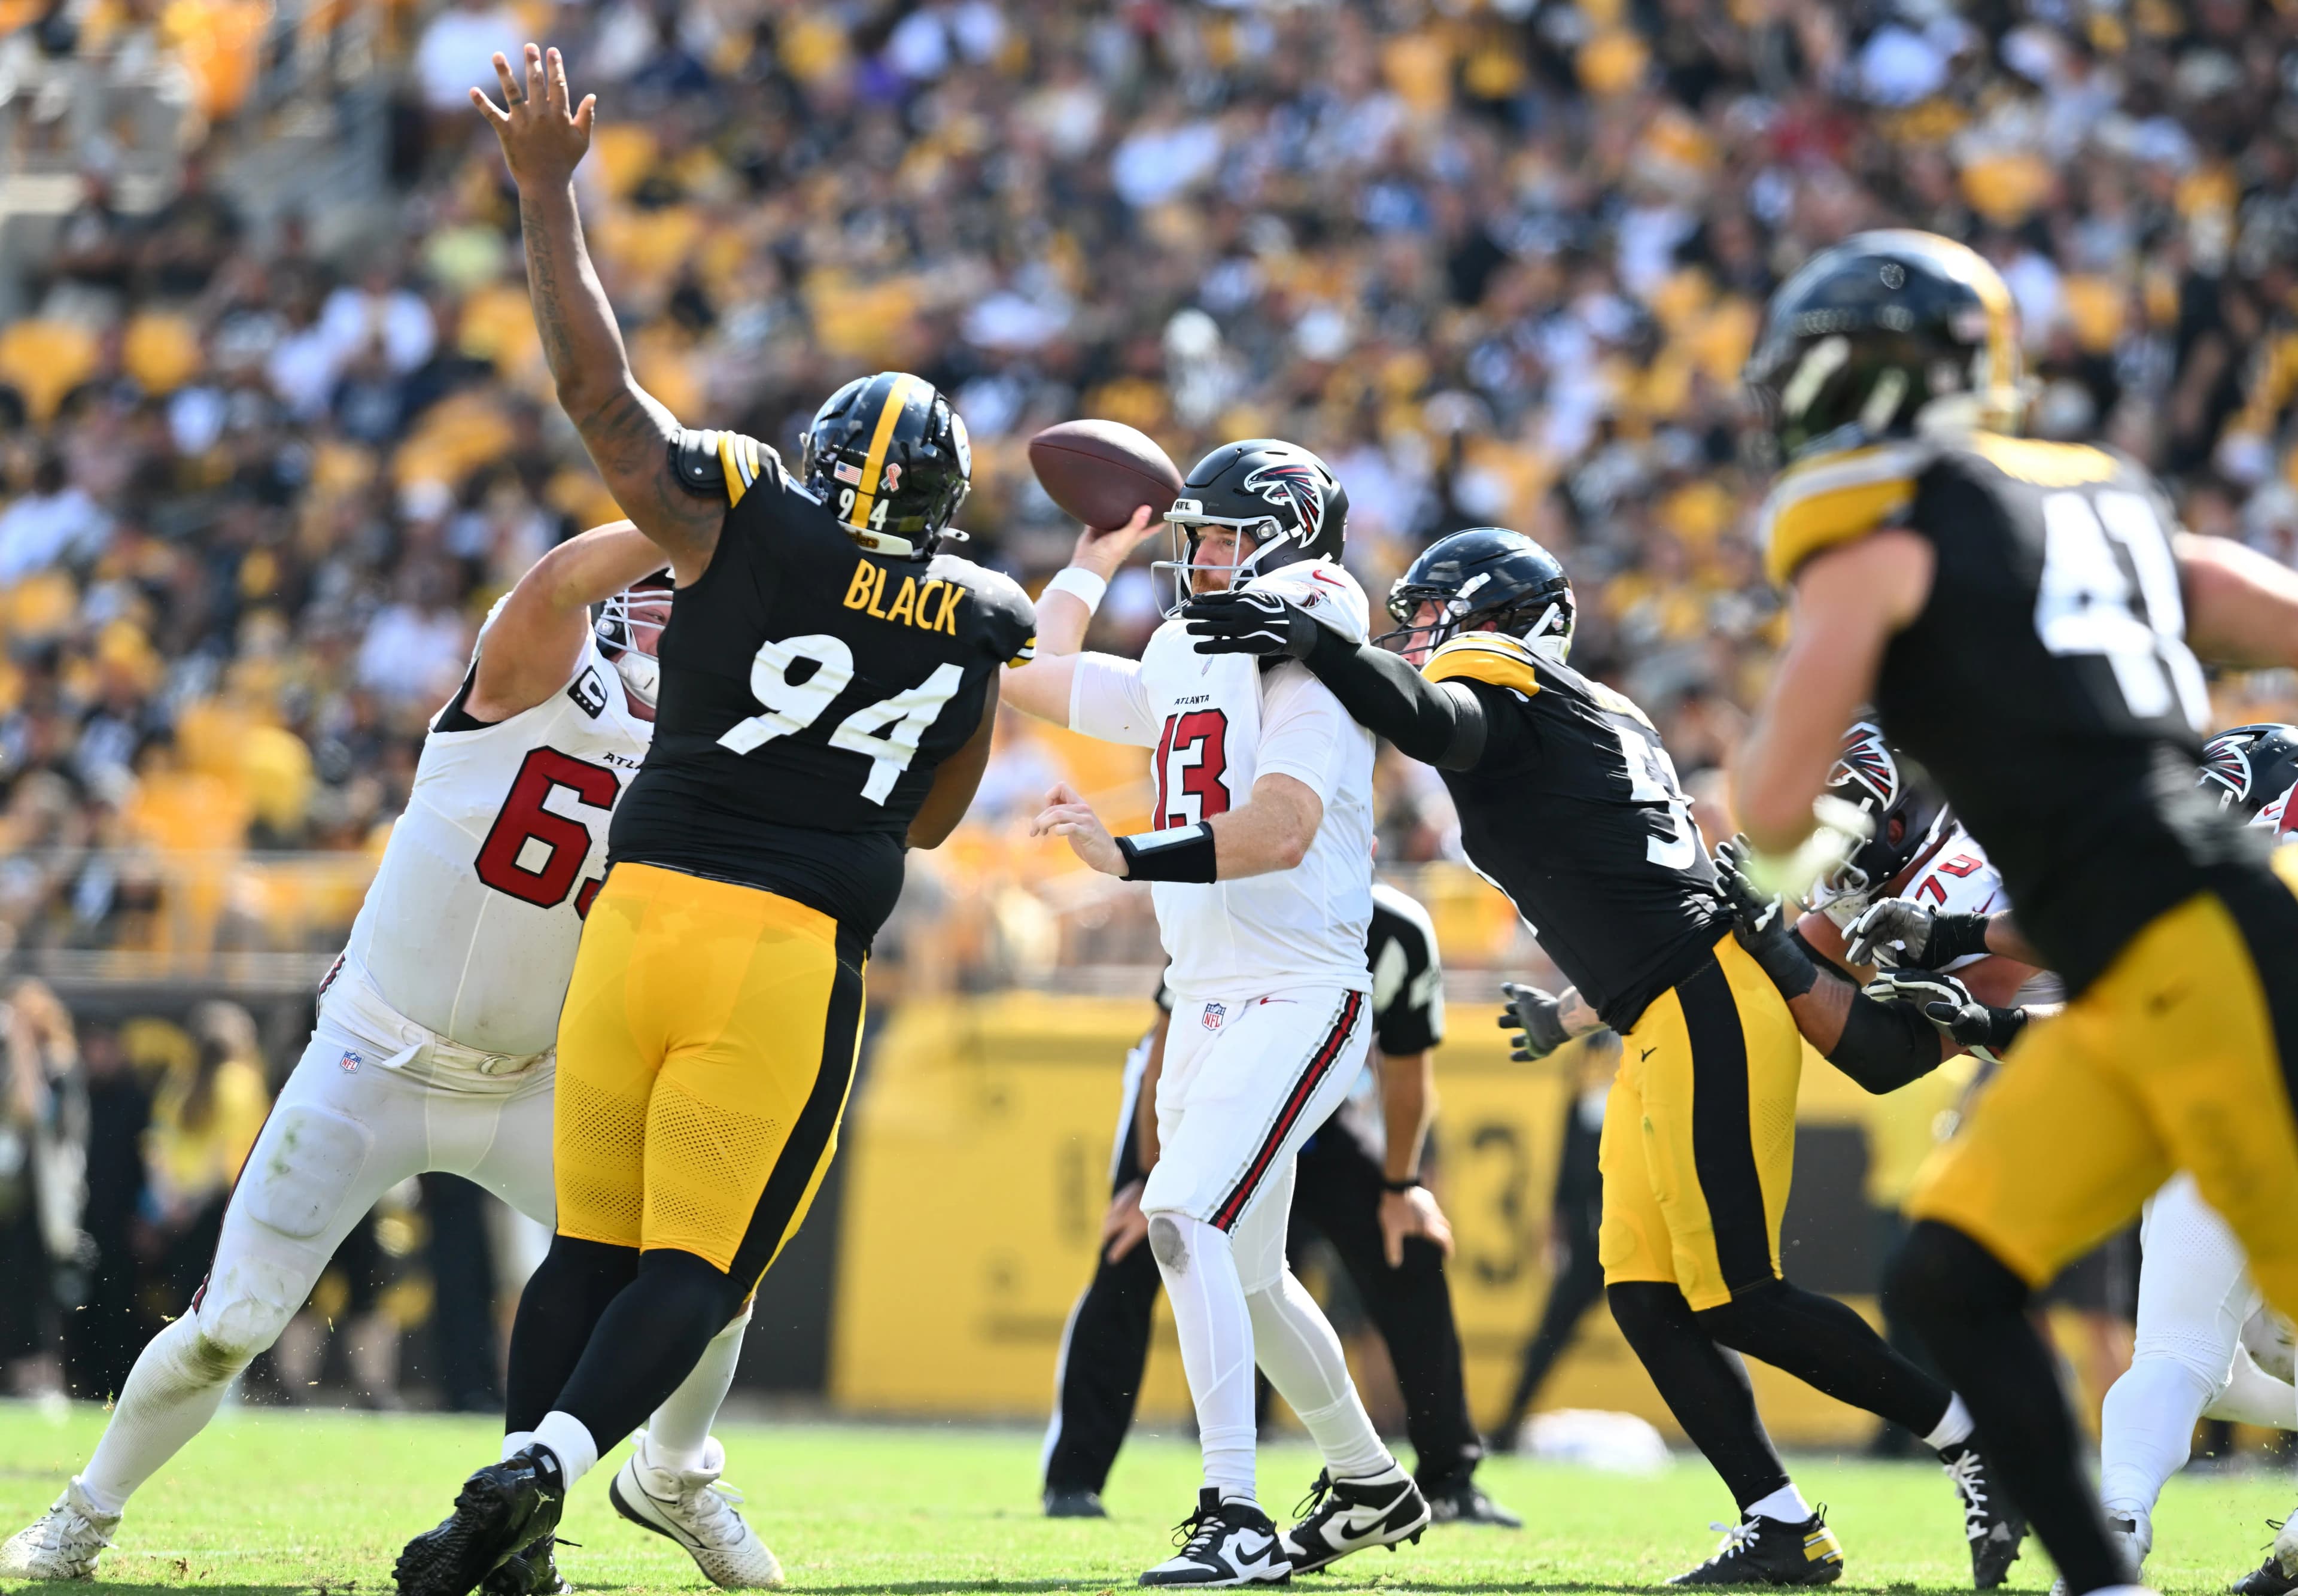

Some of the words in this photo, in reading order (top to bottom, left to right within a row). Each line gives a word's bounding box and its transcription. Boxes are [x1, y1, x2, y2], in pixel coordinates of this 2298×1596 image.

[1175, 501, 1191, 510] ATL
[843, 558, 966, 636] BLACK
[2033, 490, 2213, 734] 41
[579, 670, 606, 707] C
[716, 634, 965, 807] 94
[1174, 694, 1209, 706] ATLANTA
[1154, 707, 1230, 832] 13
[1613, 724, 1698, 870] 5
[473, 744, 621, 920] 6
[1915, 853, 1983, 907] 70
[1203, 1013, 1220, 1027] NFL
[341, 1057, 356, 1070] NFL
